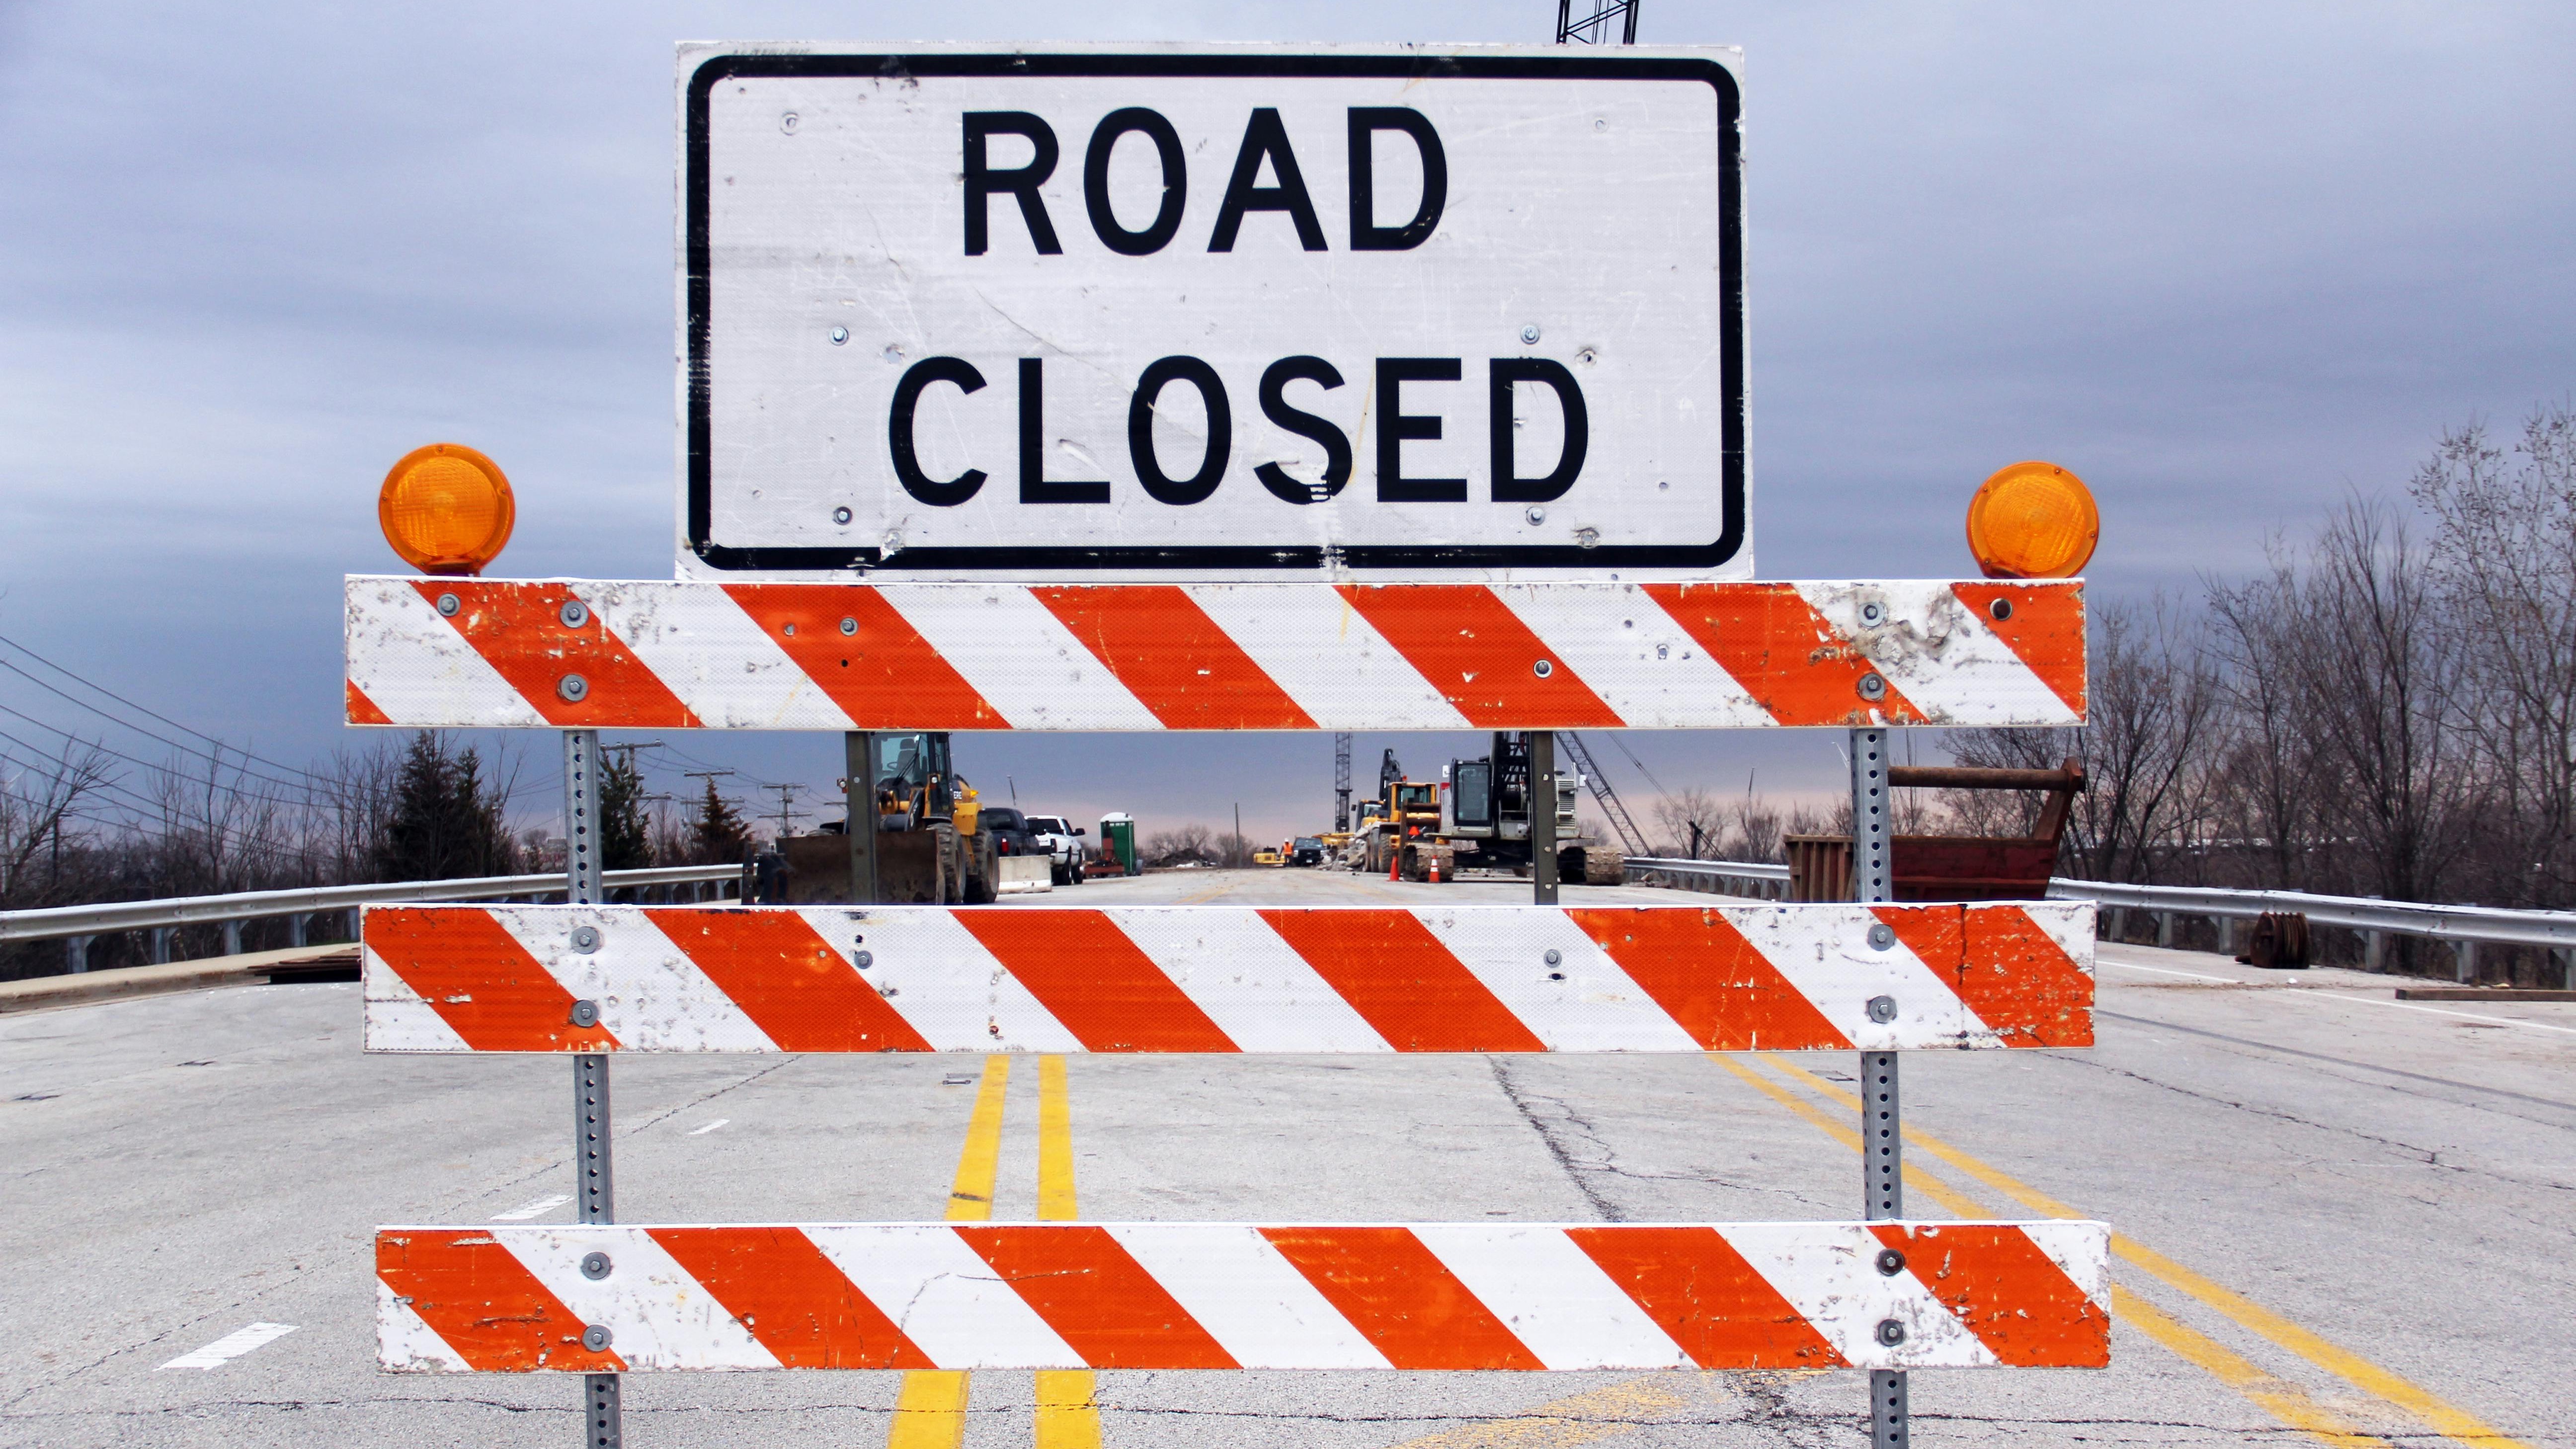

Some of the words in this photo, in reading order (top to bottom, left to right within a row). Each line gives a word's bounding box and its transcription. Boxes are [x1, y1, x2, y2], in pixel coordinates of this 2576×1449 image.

[962, 106, 1448, 256] ROAD
[888, 355, 1589, 507] CLOSED
[954, 791, 962, 800] ERE
